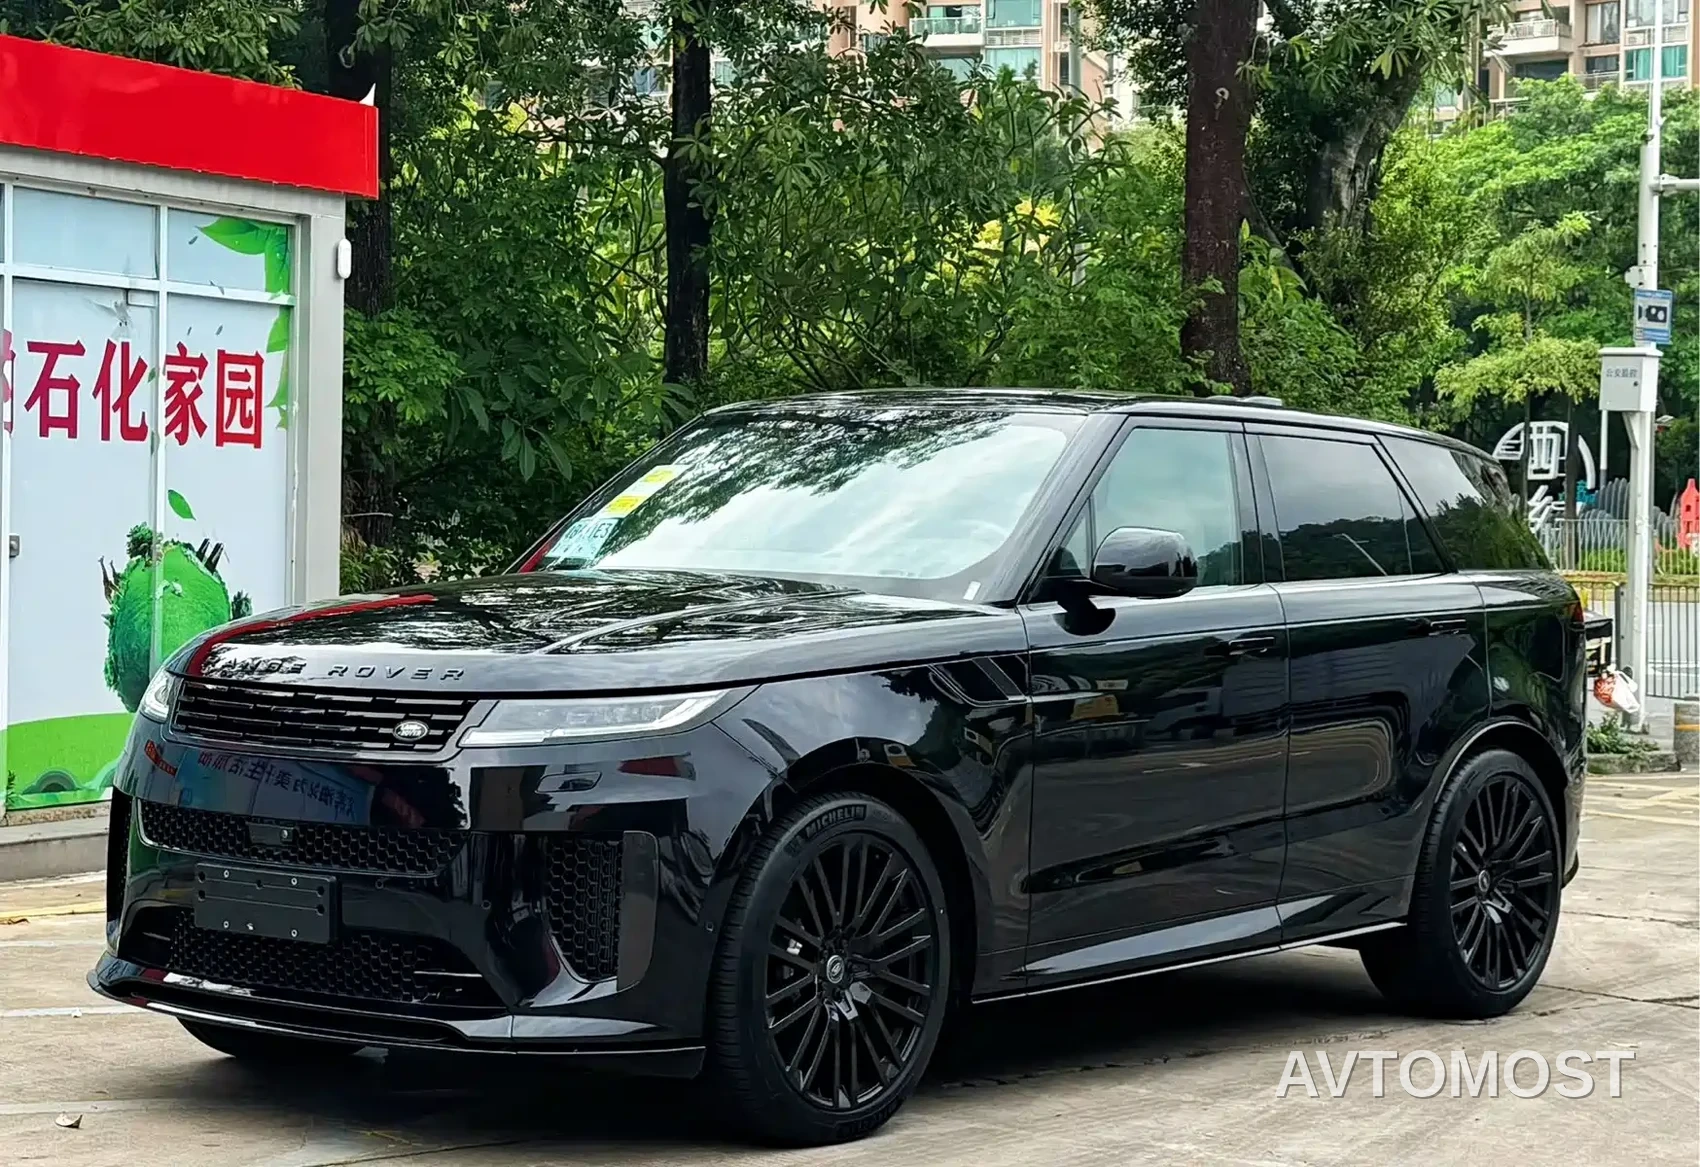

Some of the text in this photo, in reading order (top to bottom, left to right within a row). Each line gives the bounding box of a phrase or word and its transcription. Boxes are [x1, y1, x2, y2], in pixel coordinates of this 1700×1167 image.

[203, 657, 465, 681] RANGE ROVER
[806, 806, 865, 838] MICHELIN
